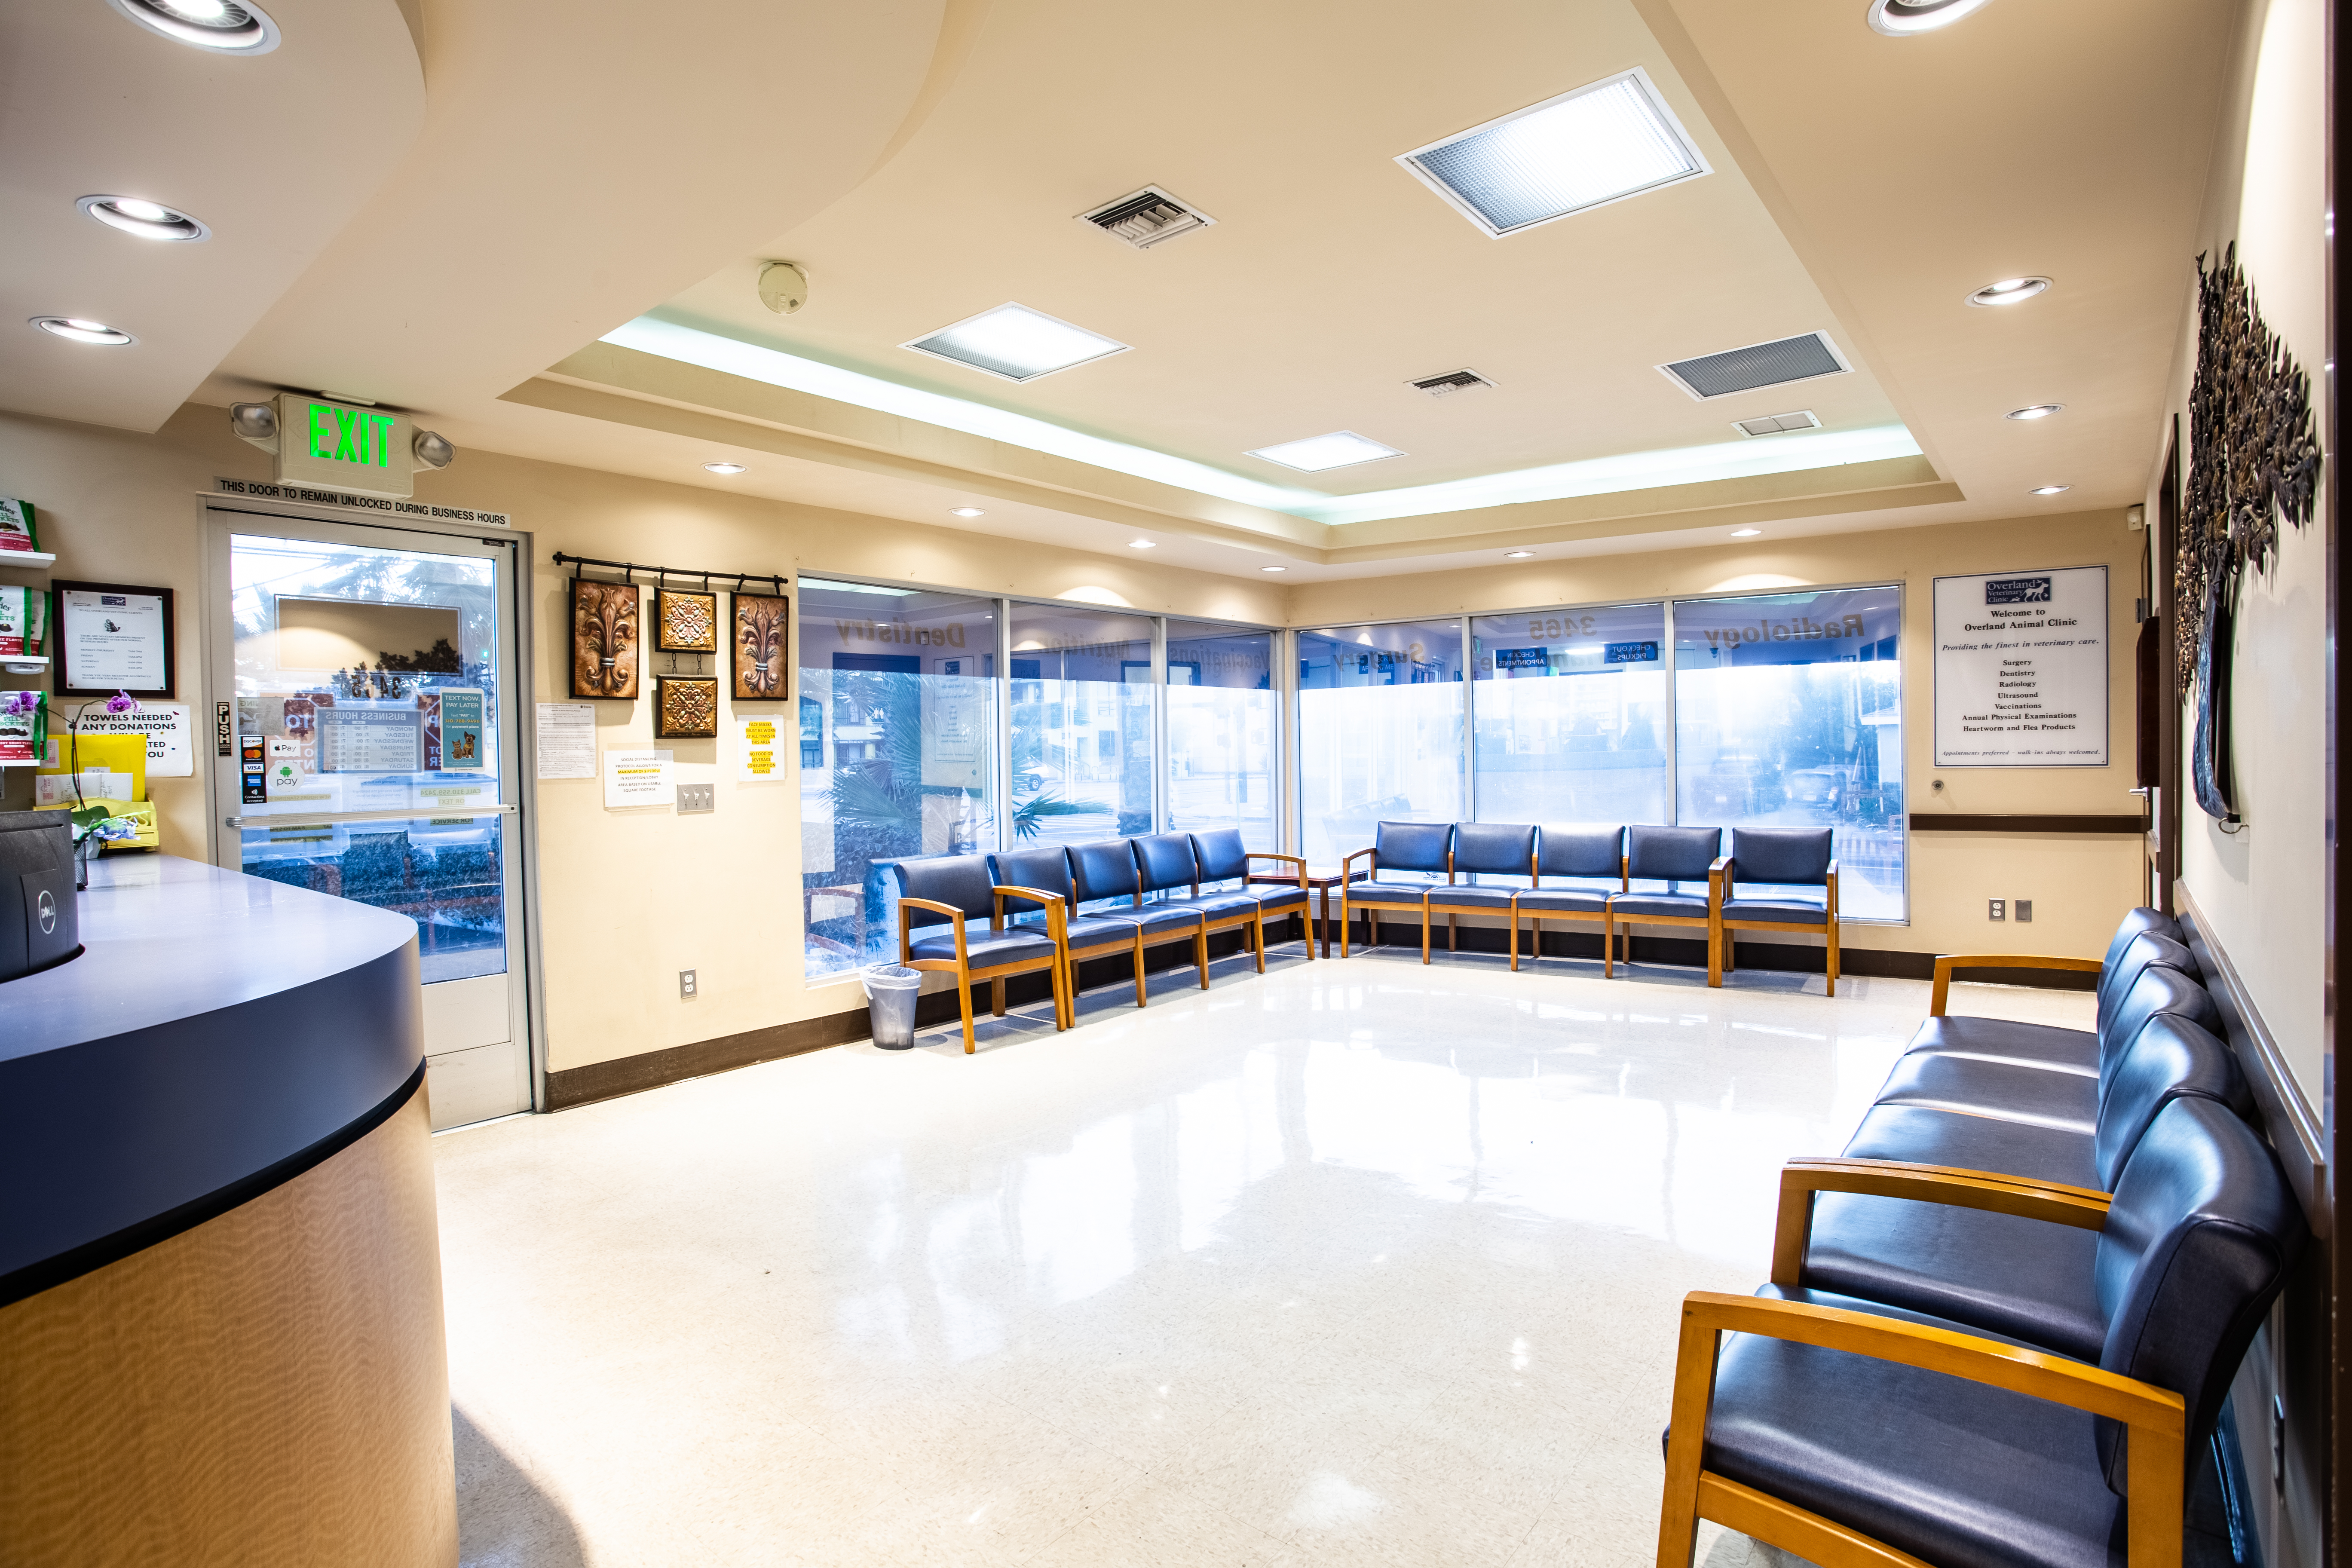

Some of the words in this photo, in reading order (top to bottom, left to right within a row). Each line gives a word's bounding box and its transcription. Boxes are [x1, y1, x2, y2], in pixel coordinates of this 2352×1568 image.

[309, 404, 393, 467] EXIT
[220, 480, 245, 492] THIS
[249, 484, 279, 496] DOOR
[283, 488, 297, 499] TO
[301, 490, 337, 504] REMAIN
[341, 495, 392, 510] UNLOCKED
[395, 502, 429, 515] DURING
[432, 507, 474, 521] BUSINESS
[478, 513, 505, 524] HOURS
[1988, 580, 2036, 591] Overland
[1991, 609, 2032, 618] Welcome
[1964, 623, 2005, 631] Overland
[2009, 620, 2044, 629] Animal
[2048, 618, 2077, 627] Clinic
[218, 705, 230, 744] PUSH
[276, 778, 298, 787] pay
[41, 905, 54, 919] DELL
